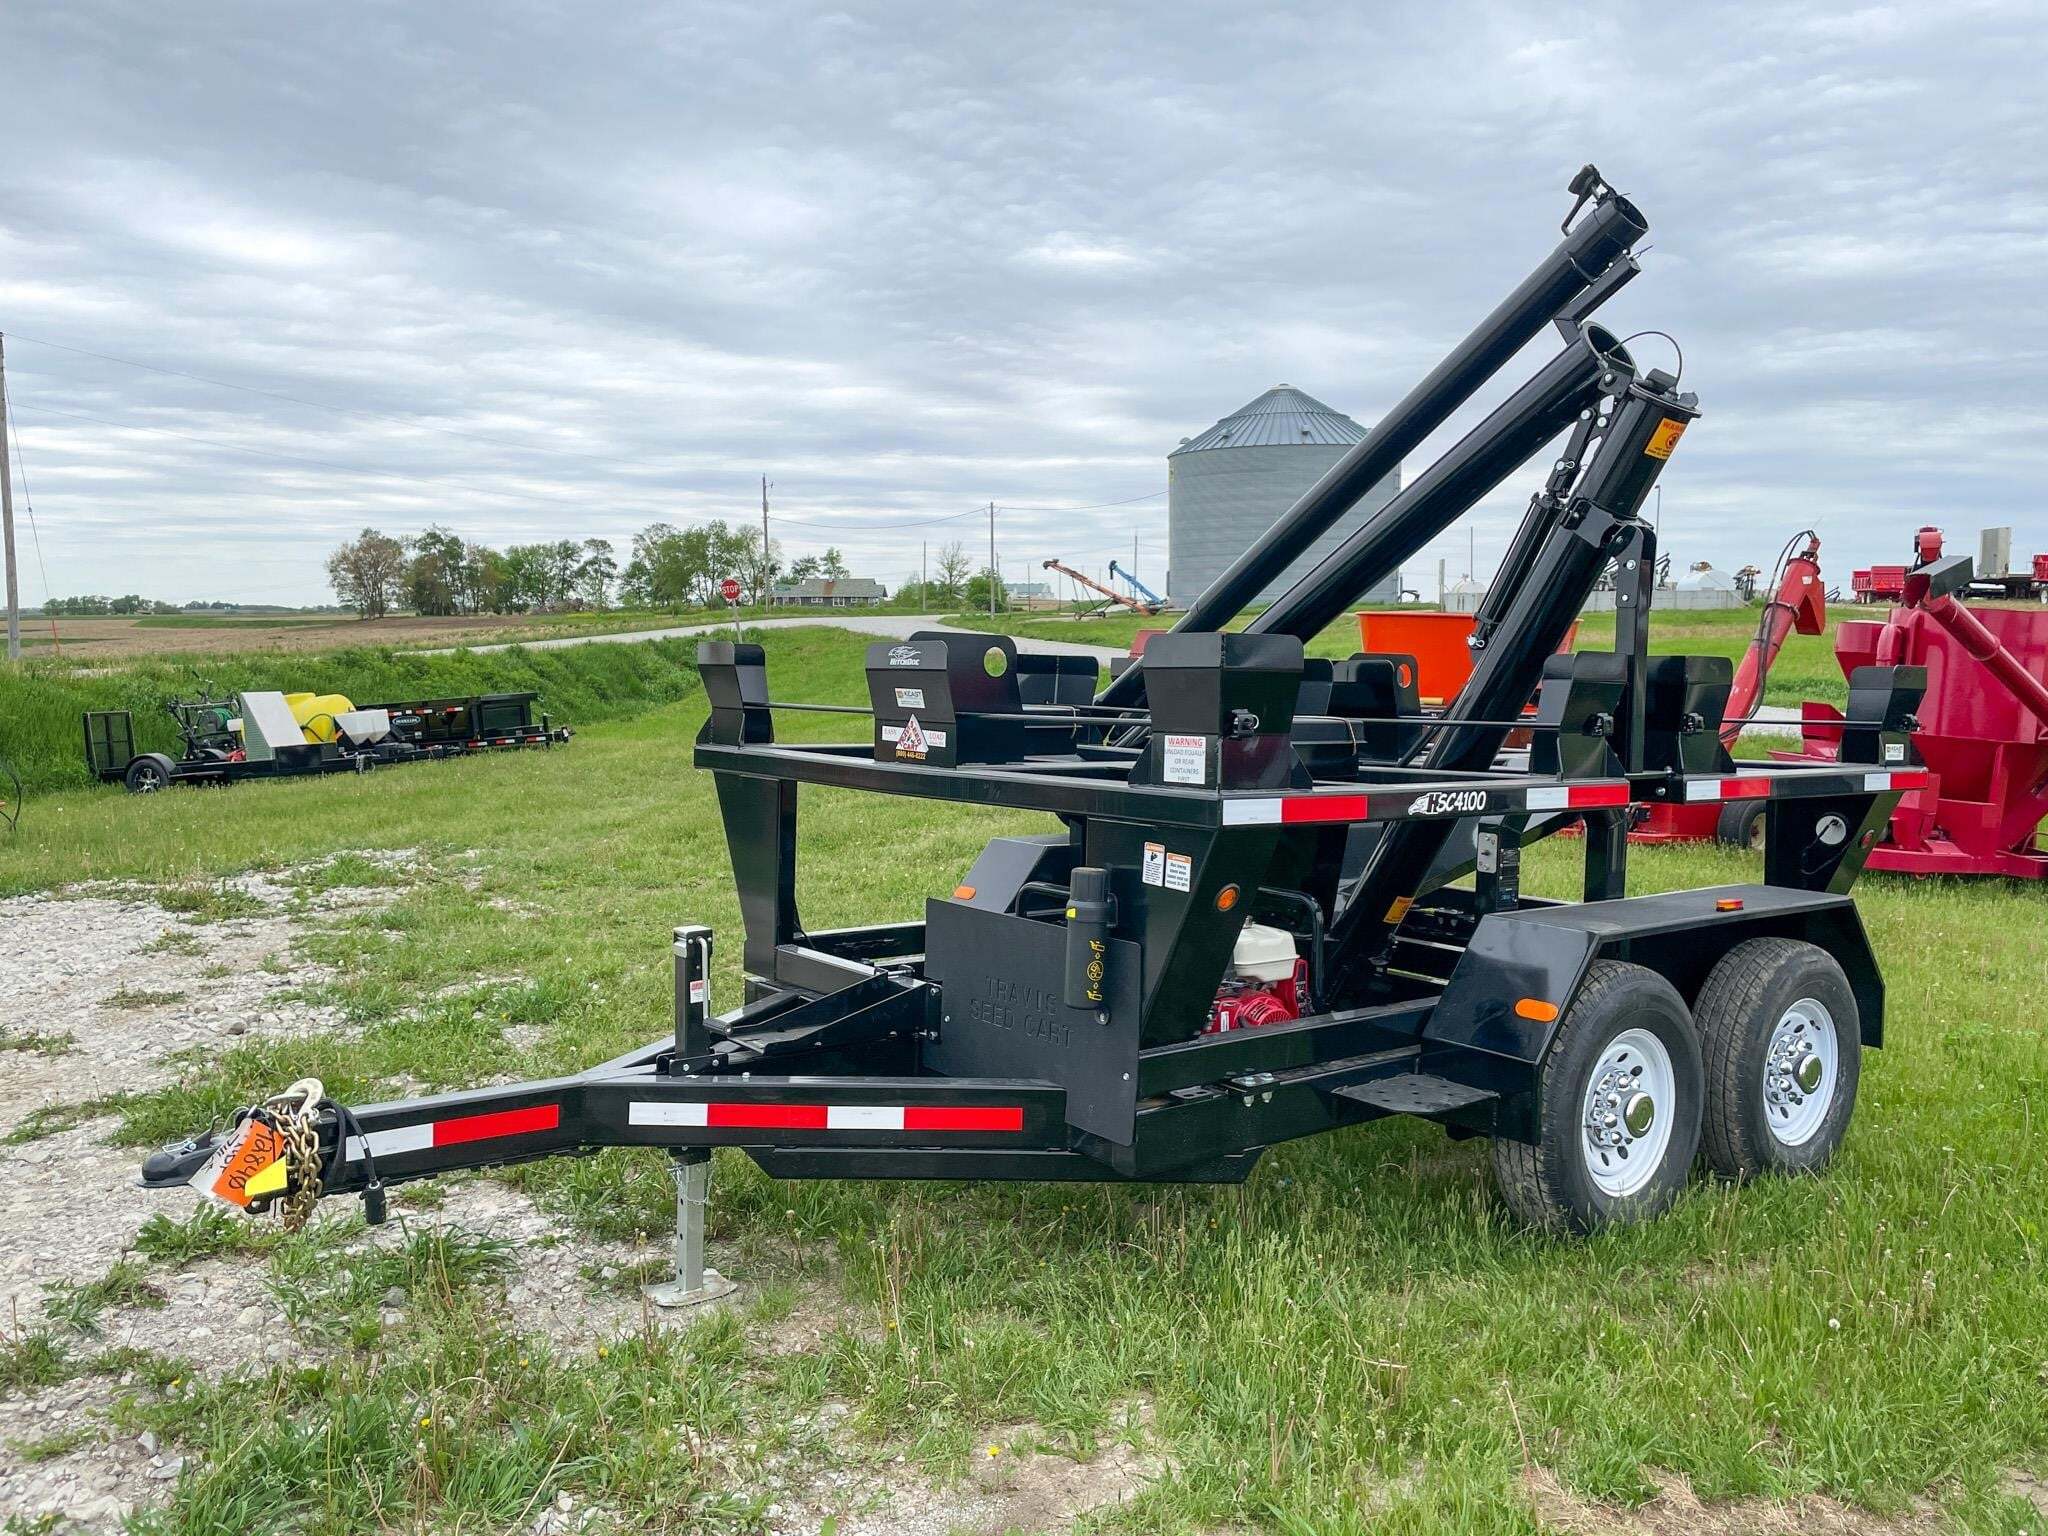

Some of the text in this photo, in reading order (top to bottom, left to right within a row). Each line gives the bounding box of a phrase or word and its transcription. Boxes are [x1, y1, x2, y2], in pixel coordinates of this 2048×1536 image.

[722, 584, 739, 595] STOP
[1167, 738, 1203, 747] WARNING
[985, 975, 1057, 1016] TRAVIS
[969, 998, 1074, 1049] SEED CART
